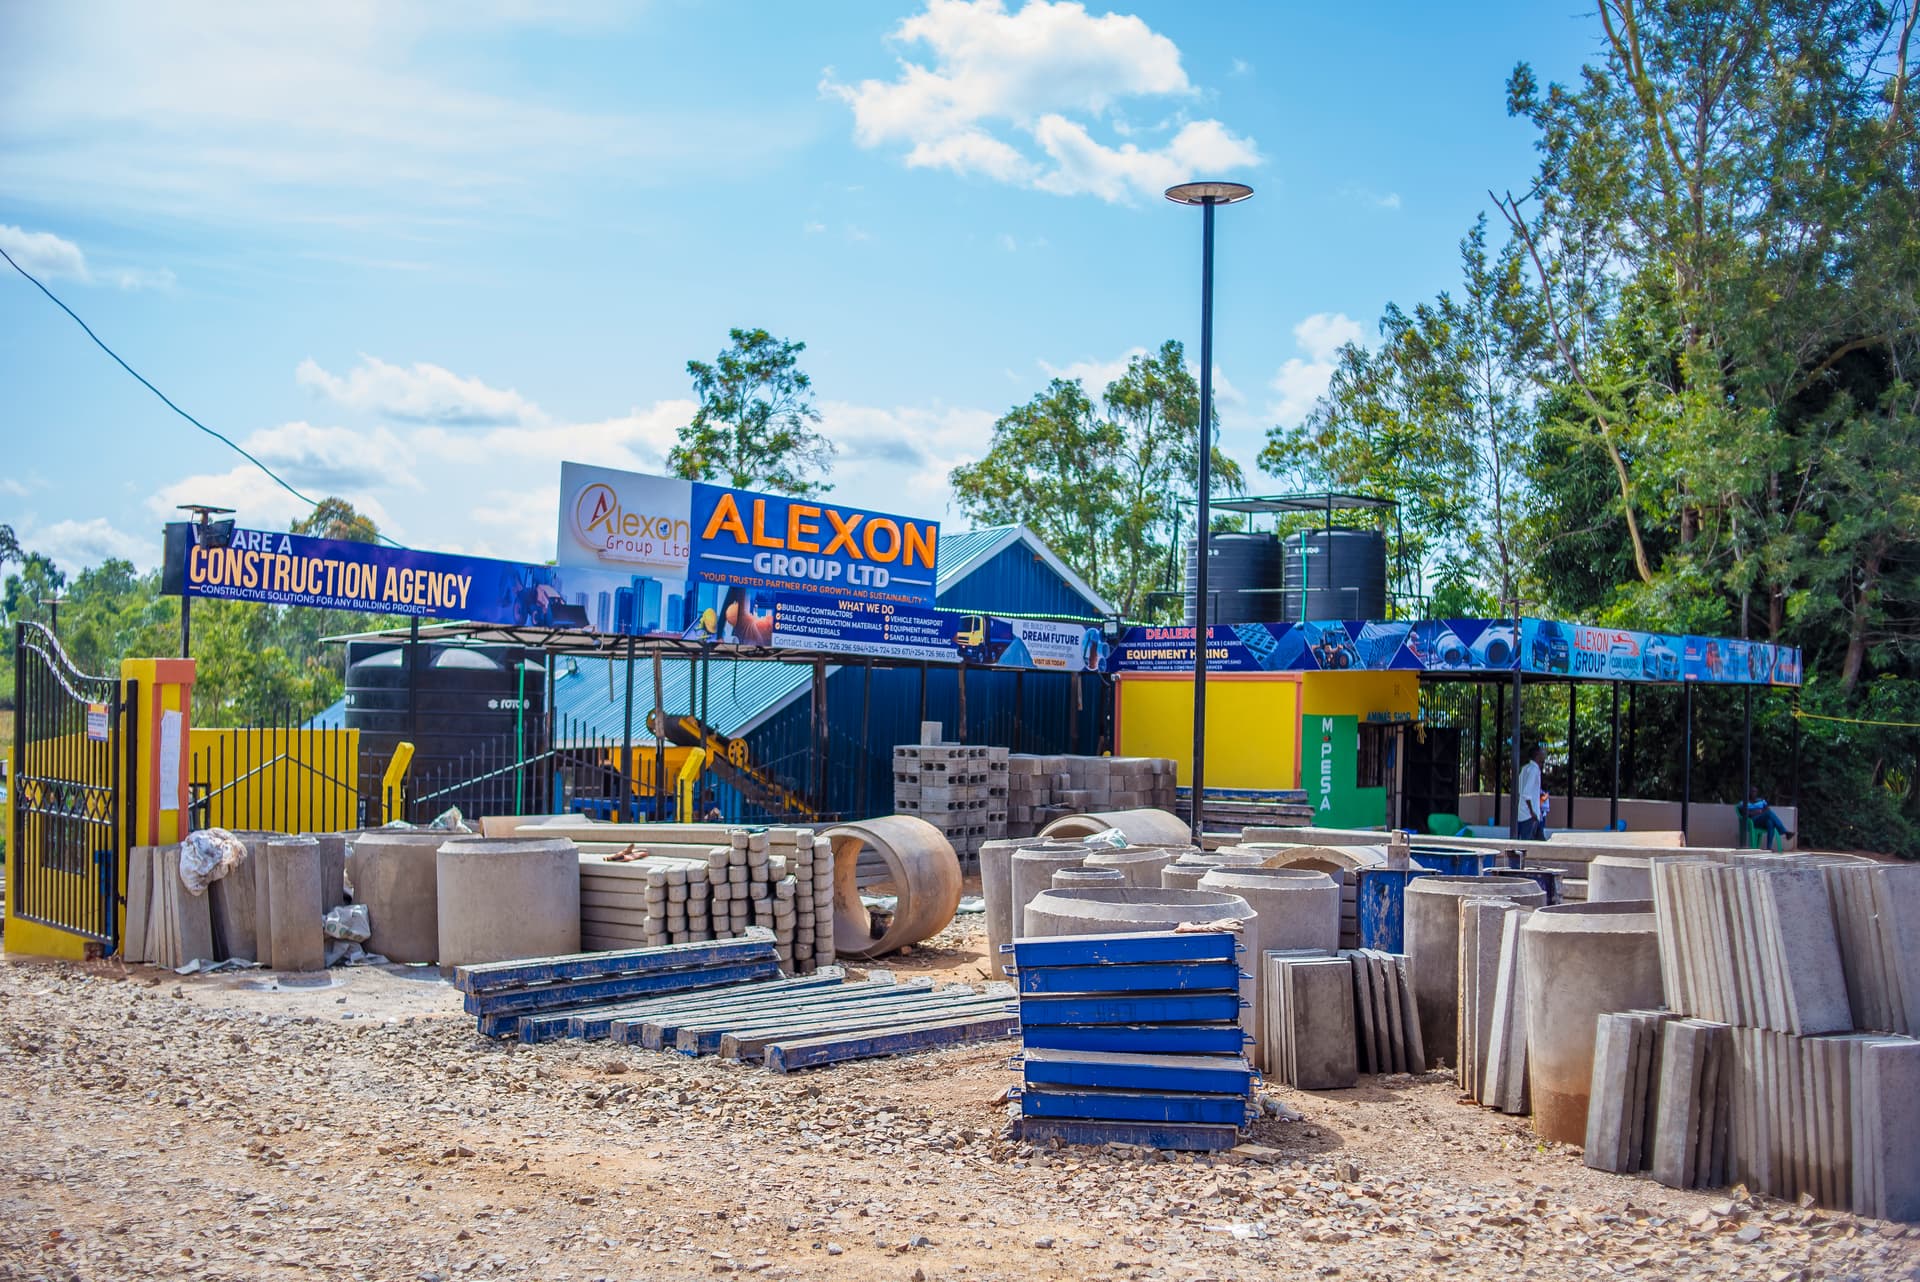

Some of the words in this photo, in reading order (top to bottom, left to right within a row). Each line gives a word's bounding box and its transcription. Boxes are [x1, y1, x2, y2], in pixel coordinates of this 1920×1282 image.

[580, 486, 689, 542] Alexon
[702, 493, 937, 569] ALEXON
[231, 530, 274, 553] ARE
[277, 535, 293, 555] A
[606, 535, 653, 556] Group
[663, 541, 690, 558] Ltd
[190, 545, 378, 600] CONSTRUCTION
[382, 566, 472, 609] AGENCY
[753, 552, 842, 581] GROUP
[847, 563, 890, 588] LTD
[729, 575, 764, 587] TRUSTED
[765, 579, 801, 591] PARTNER
[801, 583, 818, 593] FOR
[819, 585, 851, 596] GROWTH
[852, 589, 869, 599] AND
[200, 584, 266, 600] CONSTRUCTIVE
[267, 590, 315, 604] SOLUTIONS
[316, 595, 333, 606] FOR
[334, 598, 352, 608] ANY
[353, 599, 391, 611] BUILDING
[392, 602, 427, 614] PROJECT
[838, 599, 865, 613] WHAT
[866, 602, 880, 614] WE
[881, 603, 895, 615] DO
[781, 613, 796, 622] SALE
[797, 615, 805, 623] OF
[806, 616, 851, 628] CONSTRUCTION
[851, 621, 883, 631] MATERIALS
[782, 603, 810, 614] BUILDING
[811, 607, 853, 619] CONTRACTORS
[890, 615, 913, 625] VEHICLE
[913, 617, 943, 628] TRANSPORT
[780, 623, 807, 633] PRECAST
[808, 626, 841, 636] MATERIALS
[889, 624, 921, 634] EQUIPMENT
[1022, 629, 1050, 643] DREAM
[1050, 633, 1080, 645] FUTURE
[774, 636, 802, 647] Contact
[1574, 630, 1609, 653] ALEXON
[1126, 648, 1187, 661] EQUIPMENT
[1190, 648, 1228, 660] HRING
[1575, 651, 1607, 673] GROUP
